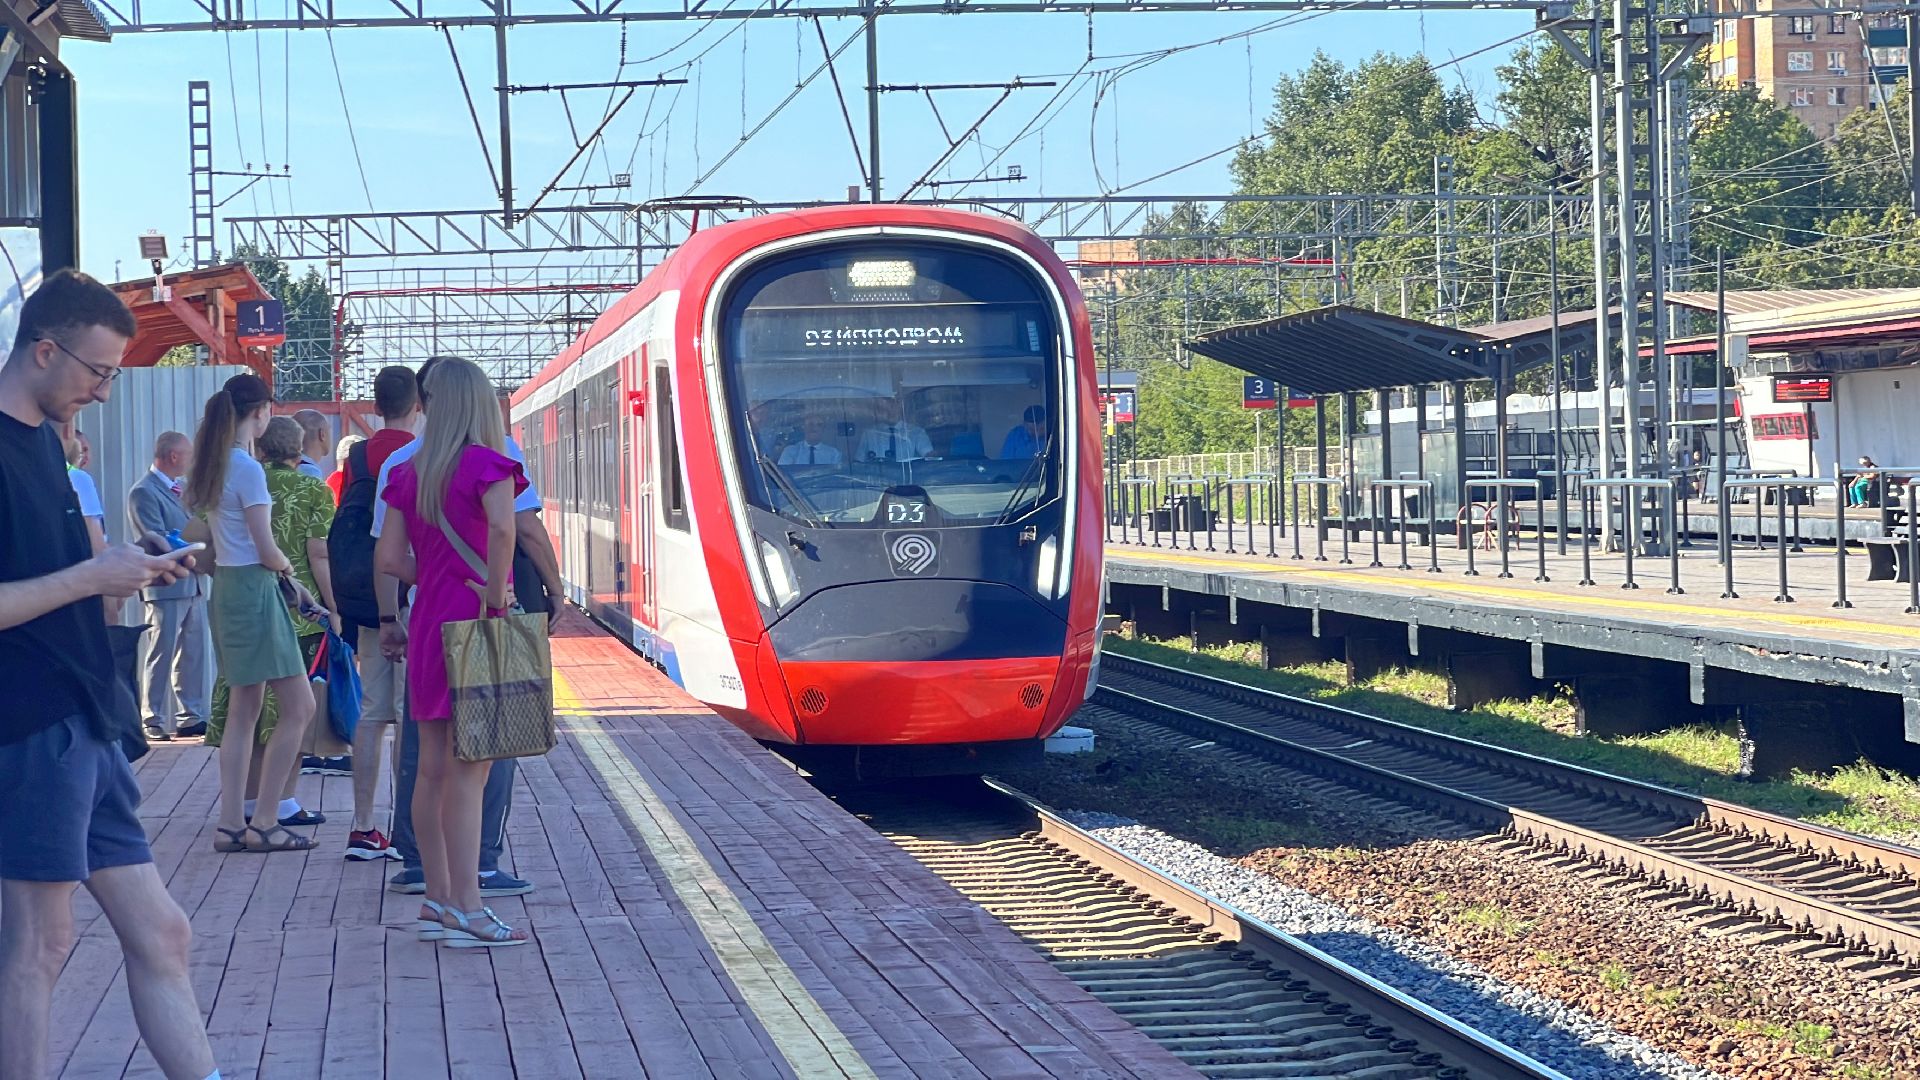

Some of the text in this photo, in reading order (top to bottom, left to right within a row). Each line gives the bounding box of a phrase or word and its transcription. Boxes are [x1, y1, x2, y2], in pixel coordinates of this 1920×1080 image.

[255, 305, 264, 325] 1
[1254, 379, 1264, 394] 3
[888, 502, 924, 522] D3
